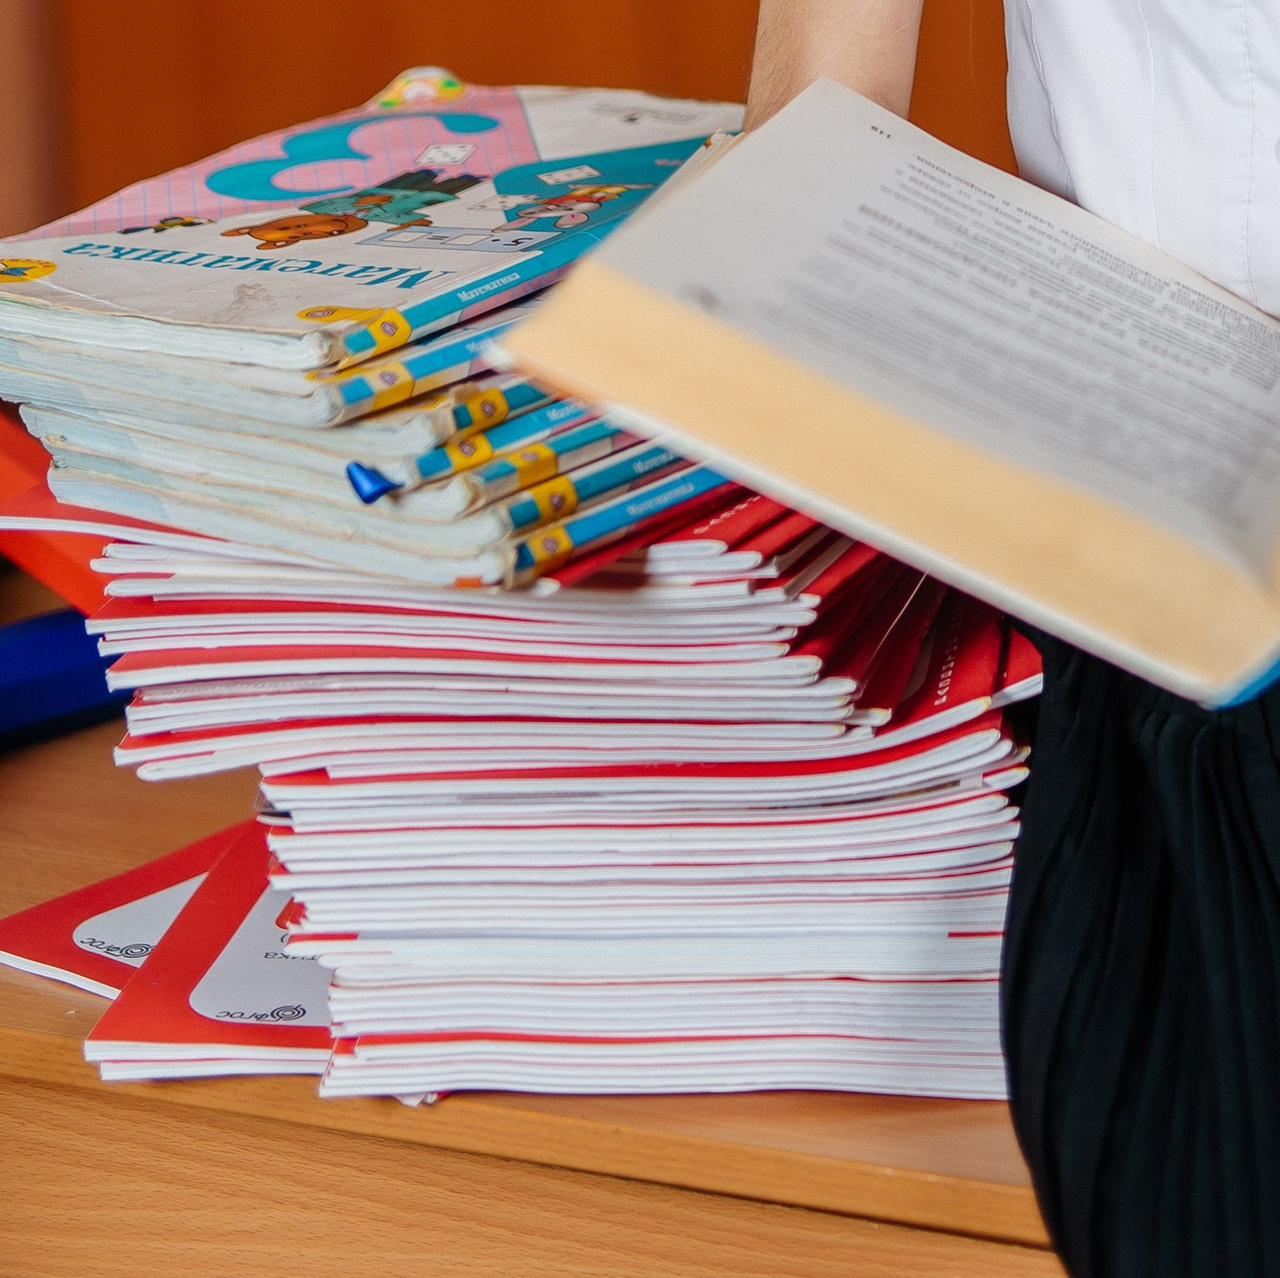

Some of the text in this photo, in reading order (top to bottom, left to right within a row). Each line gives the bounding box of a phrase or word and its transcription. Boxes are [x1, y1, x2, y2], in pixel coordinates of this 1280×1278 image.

[62, 243, 455, 290] Математика
[457, 272, 521, 303] Математика
[216, 1010, 269, 1021] ФГОС
